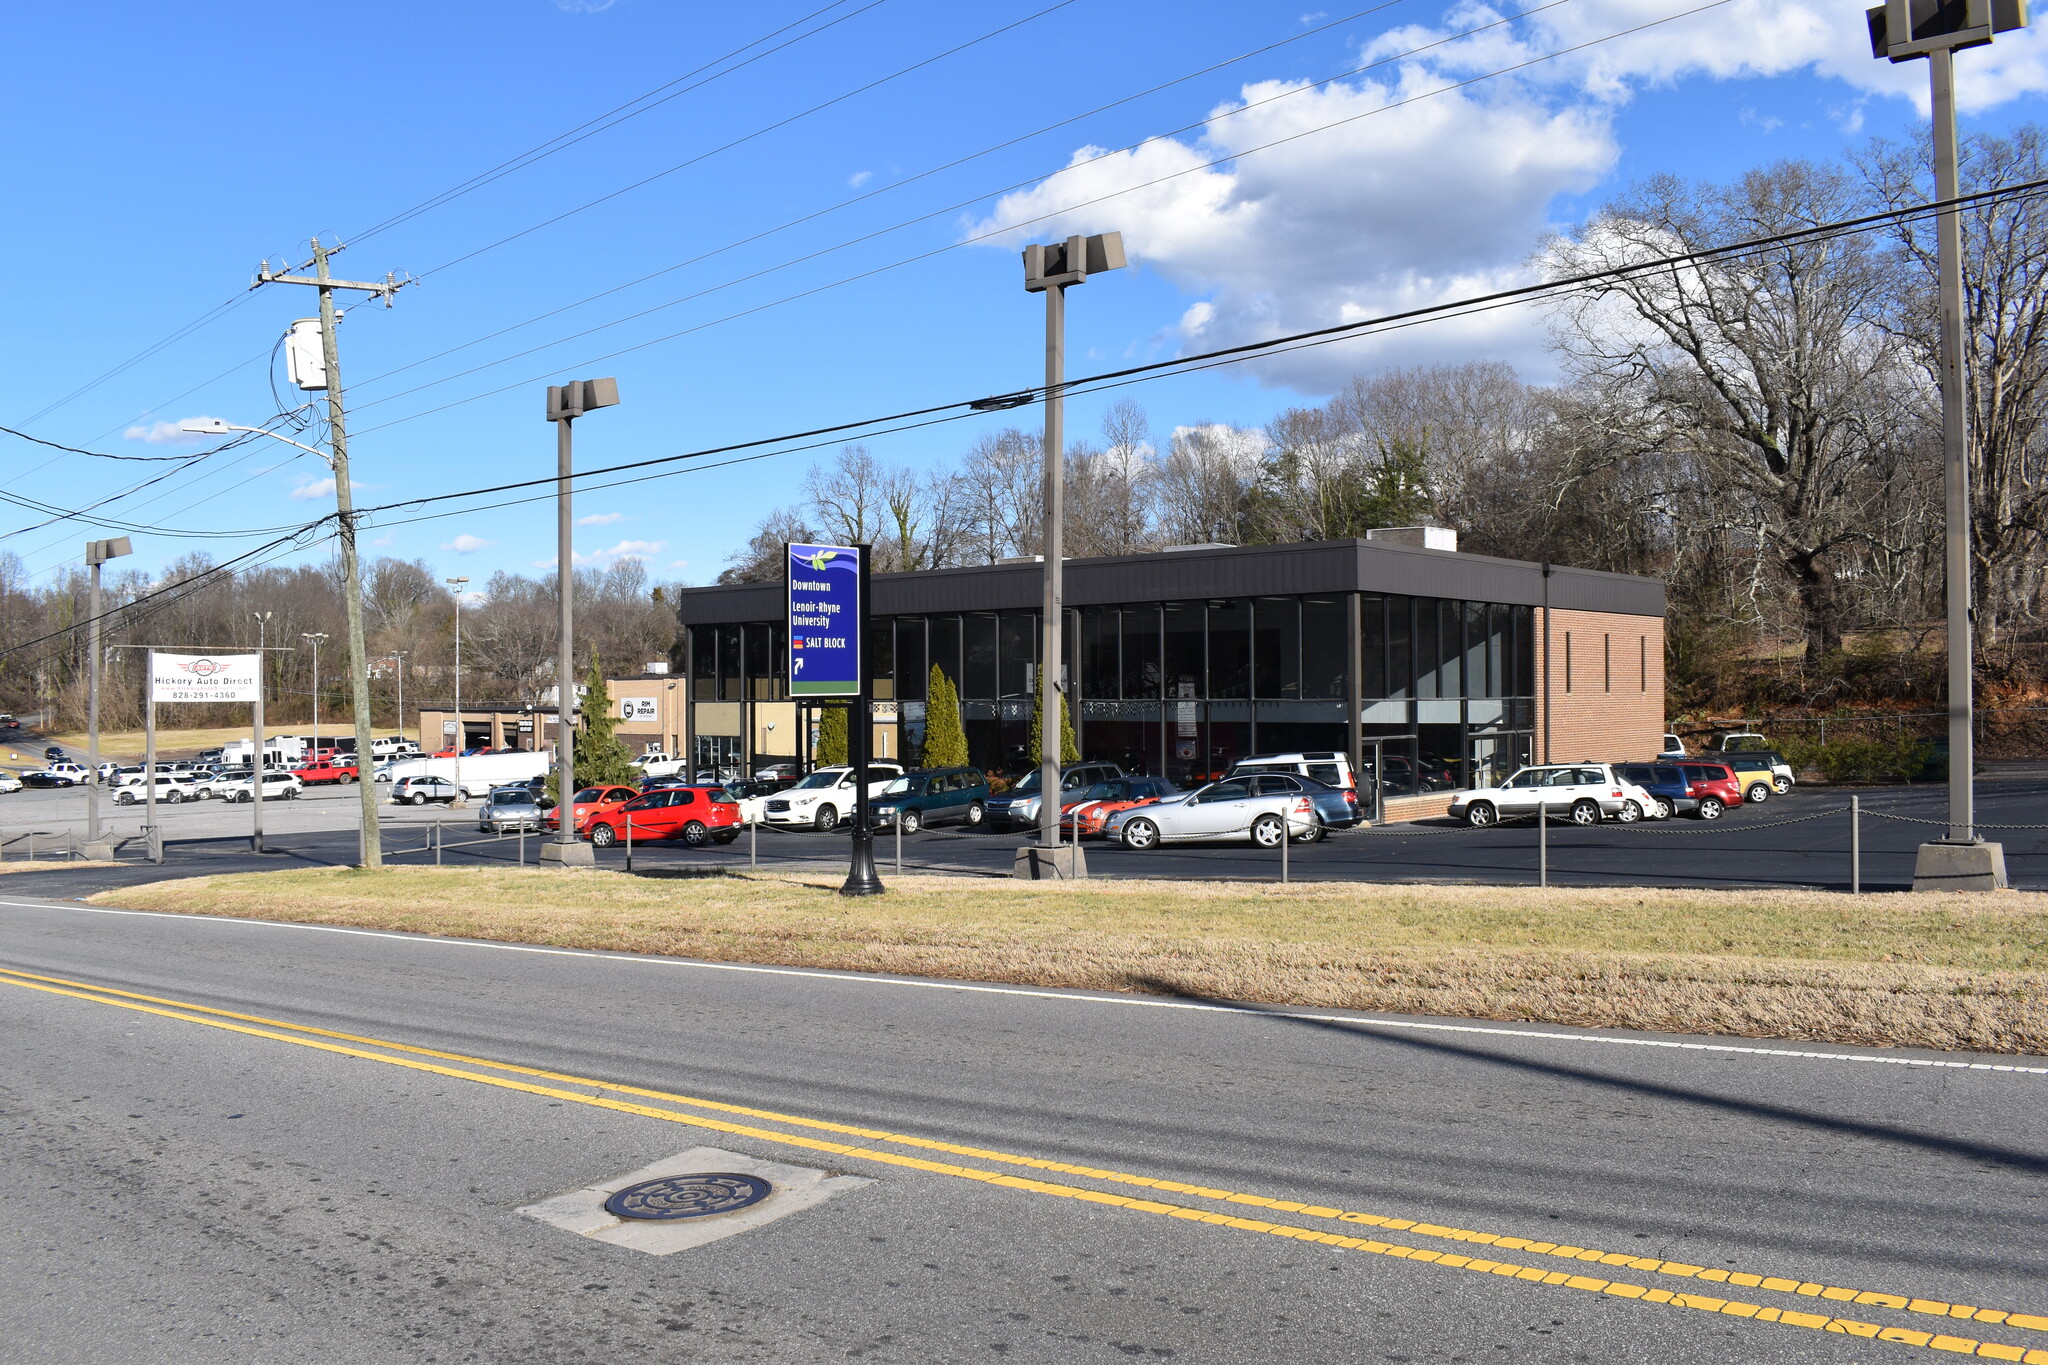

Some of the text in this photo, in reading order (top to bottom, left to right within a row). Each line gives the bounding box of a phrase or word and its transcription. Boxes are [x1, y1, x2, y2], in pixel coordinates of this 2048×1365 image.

[793, 579, 831, 592] Downtown
[793, 601, 840, 615] Lenoir-Rhyne
[793, 615, 830, 629] University
[806, 637, 846, 648] SALT BLOCK
[154, 677, 253, 686] Hickory Auto Direct
